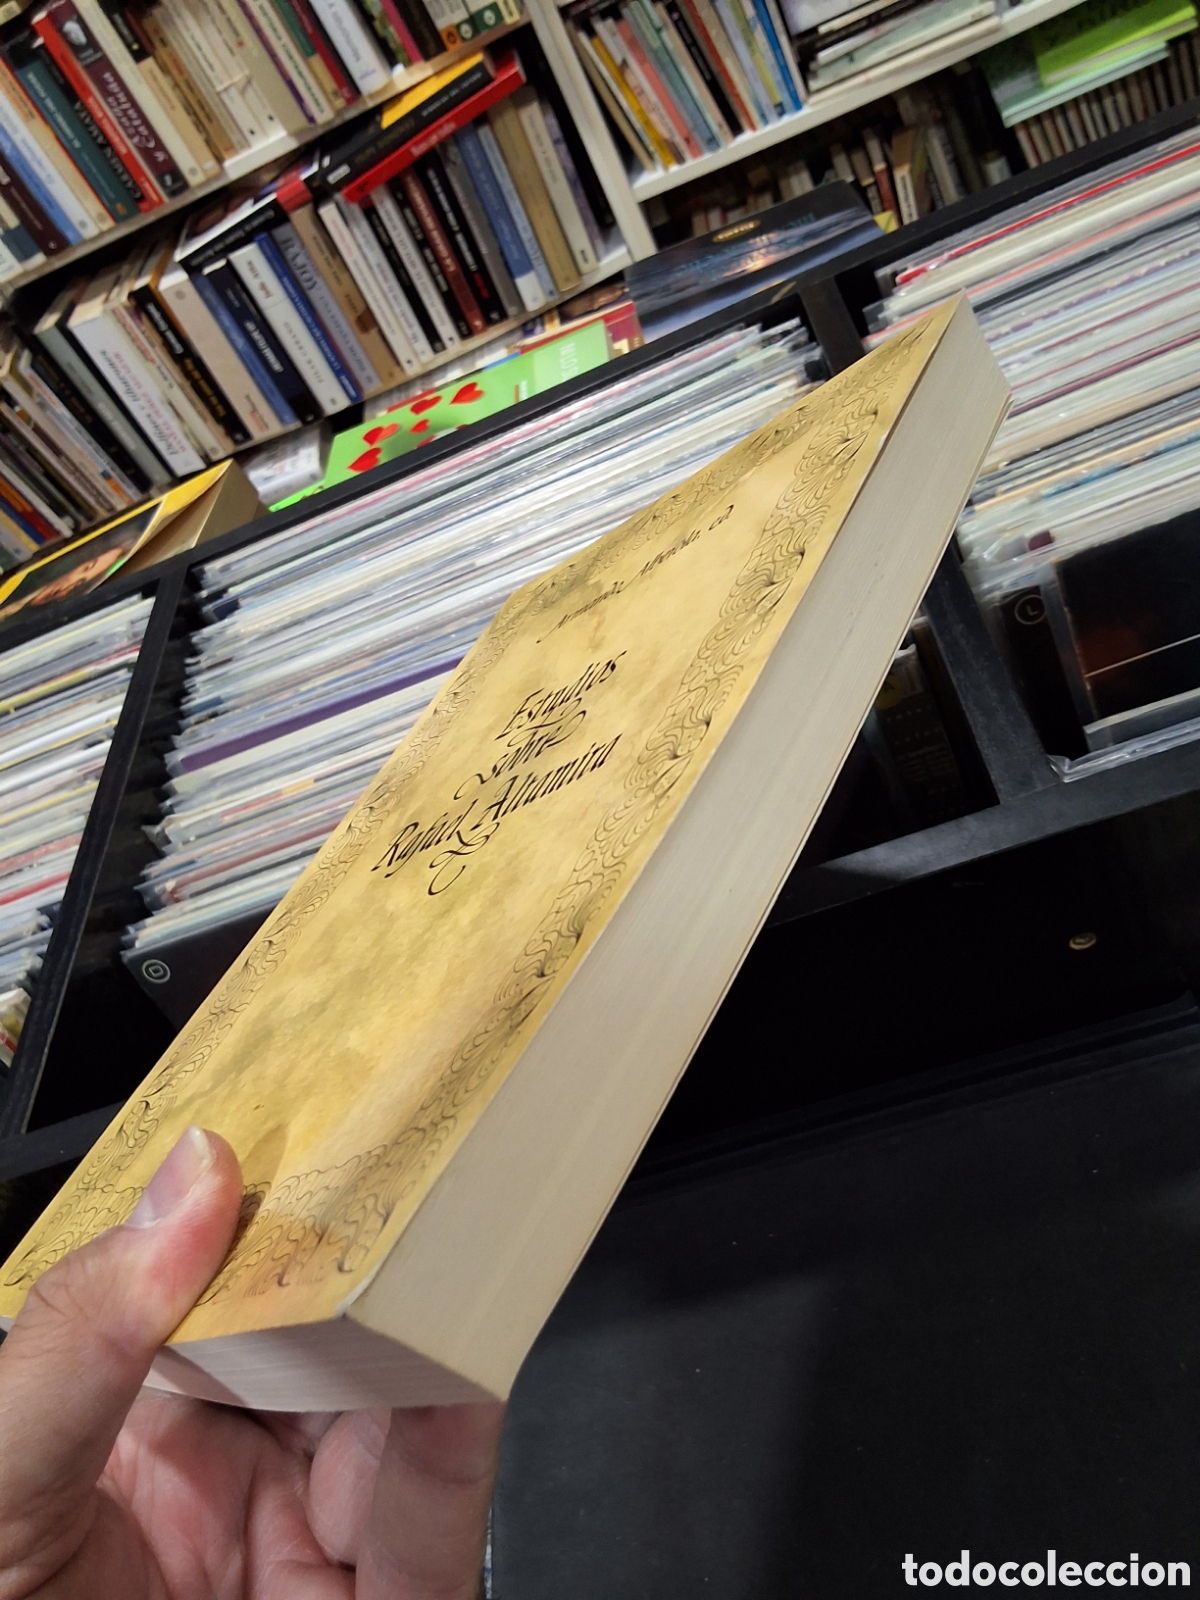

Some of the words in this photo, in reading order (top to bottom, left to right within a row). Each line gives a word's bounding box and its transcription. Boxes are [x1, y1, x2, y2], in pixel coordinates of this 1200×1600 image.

[142, 410, 178, 458] Delfines
[494, 650, 627, 742] Estudios
[470, 734, 622, 831] Altamira
